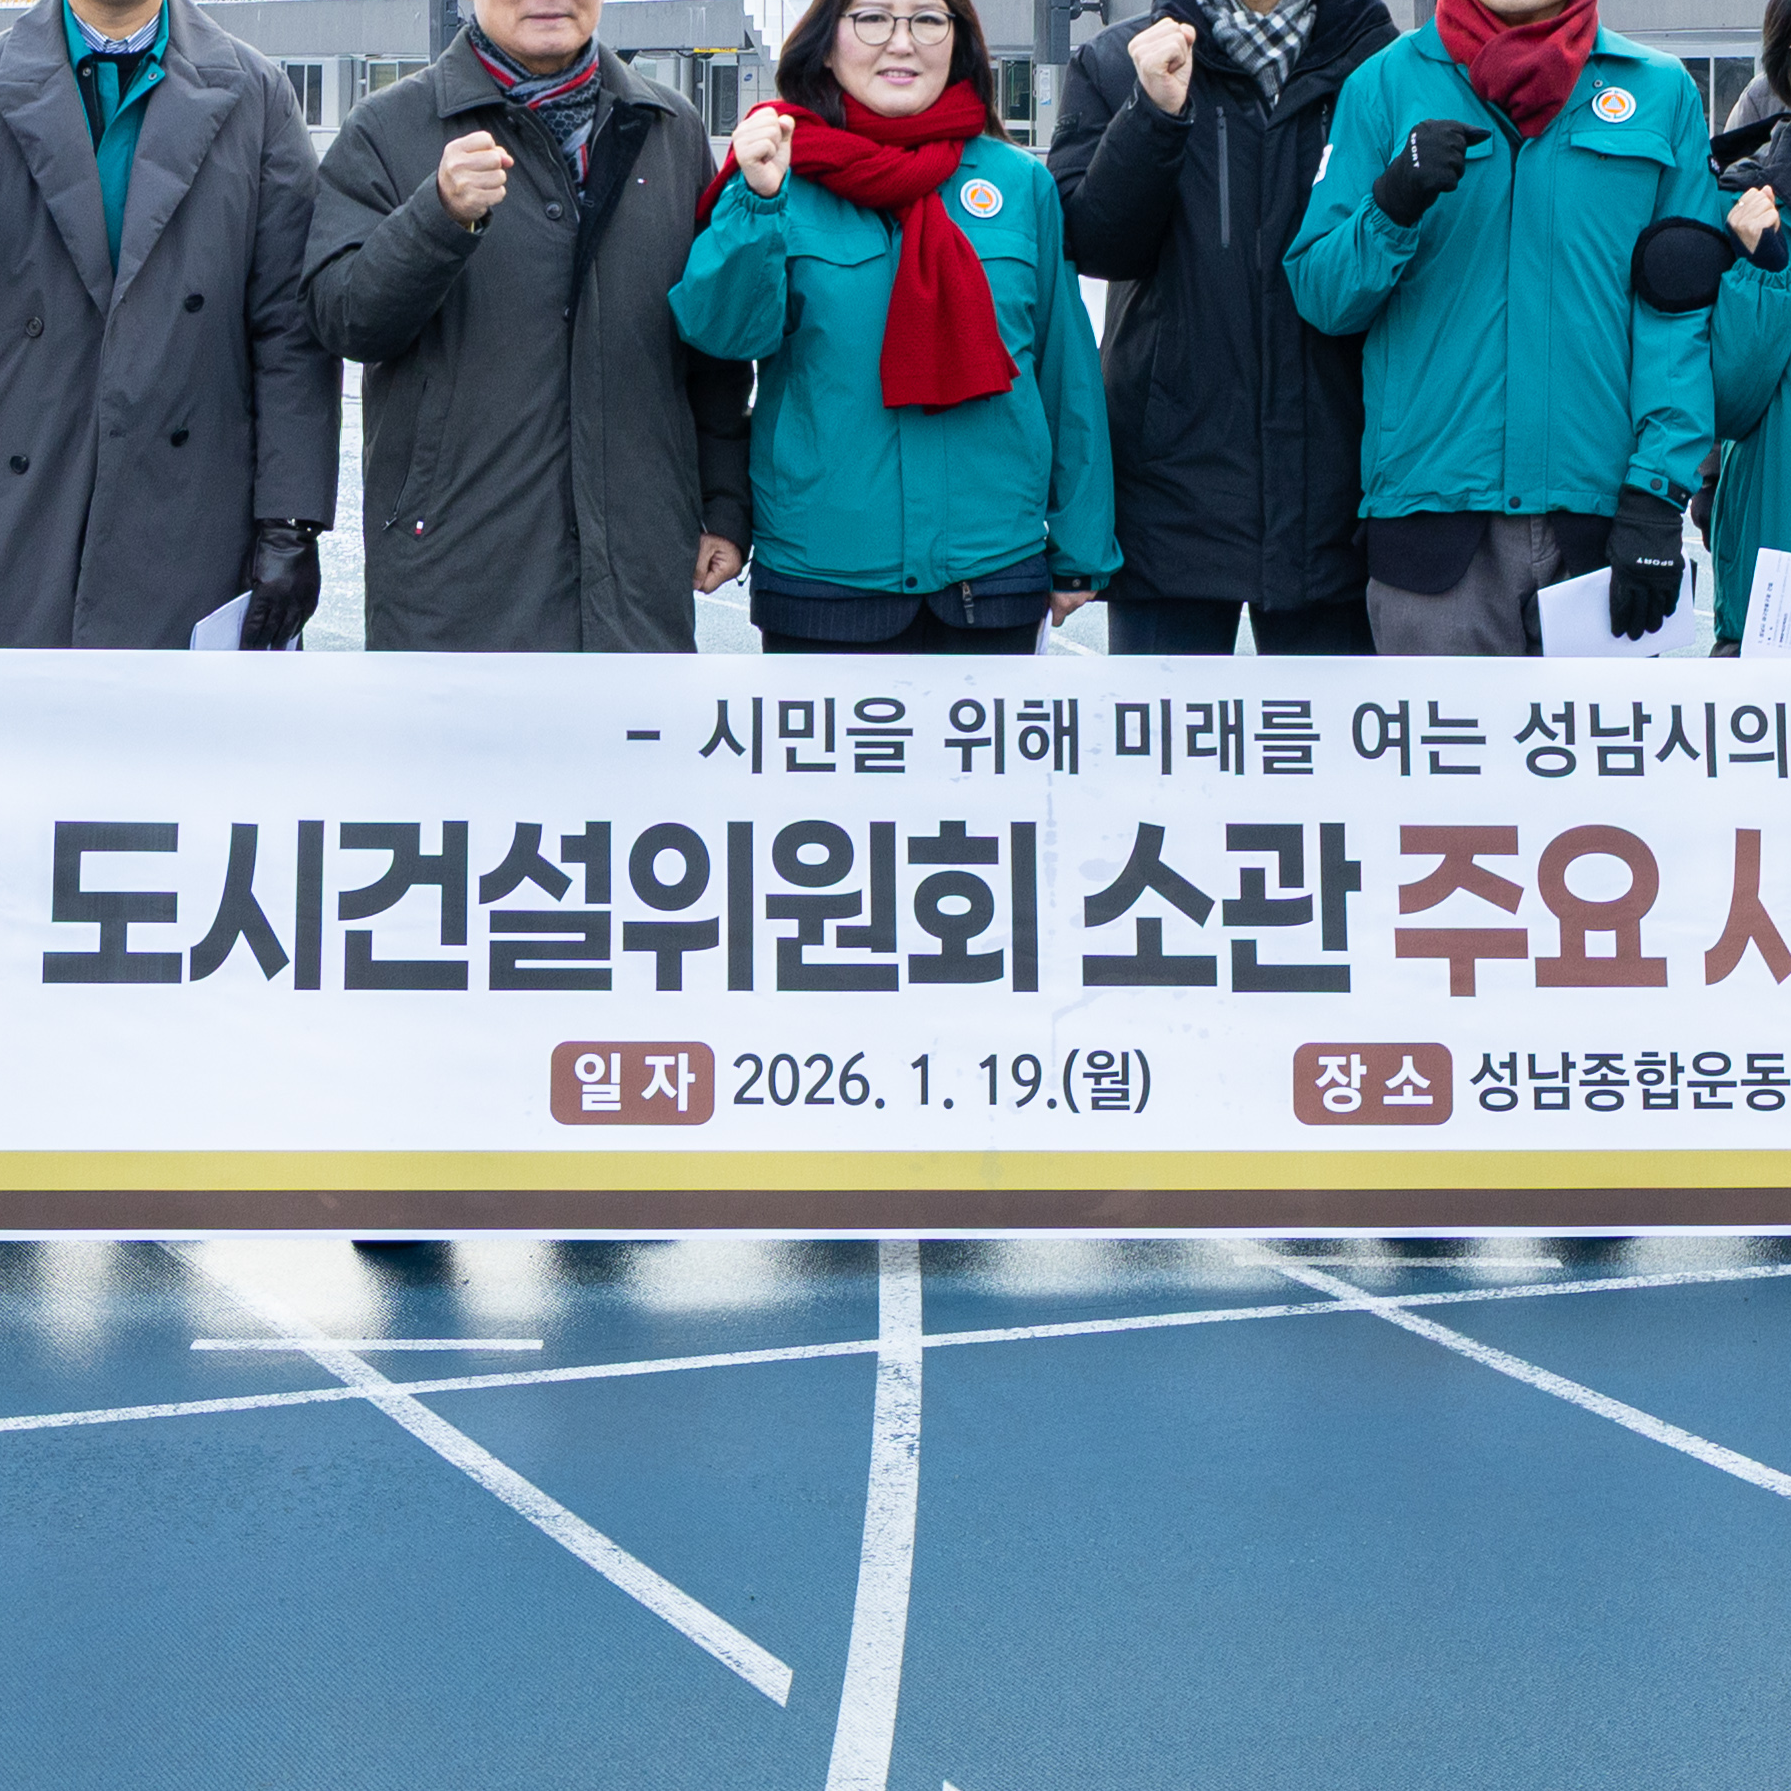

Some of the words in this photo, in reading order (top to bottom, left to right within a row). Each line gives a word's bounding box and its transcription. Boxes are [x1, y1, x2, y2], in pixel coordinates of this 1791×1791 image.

[700, 697, 913, 774] 시민을
[945, 699, 1078, 775] 위해
[1115, 699, 1320, 775] 미래를
[1352, 700, 1486, 776] 여는
[43, 820, 1038, 992] 도시건설위원회
[1083, 822, 1361, 993] 소관
[1395, 825, 1667, 997] 주요
[732, 1051, 886, 1110] 2026.
[911, 1053, 954, 1110] 1.
[978, 1048, 1151, 1114] 19.(월)
